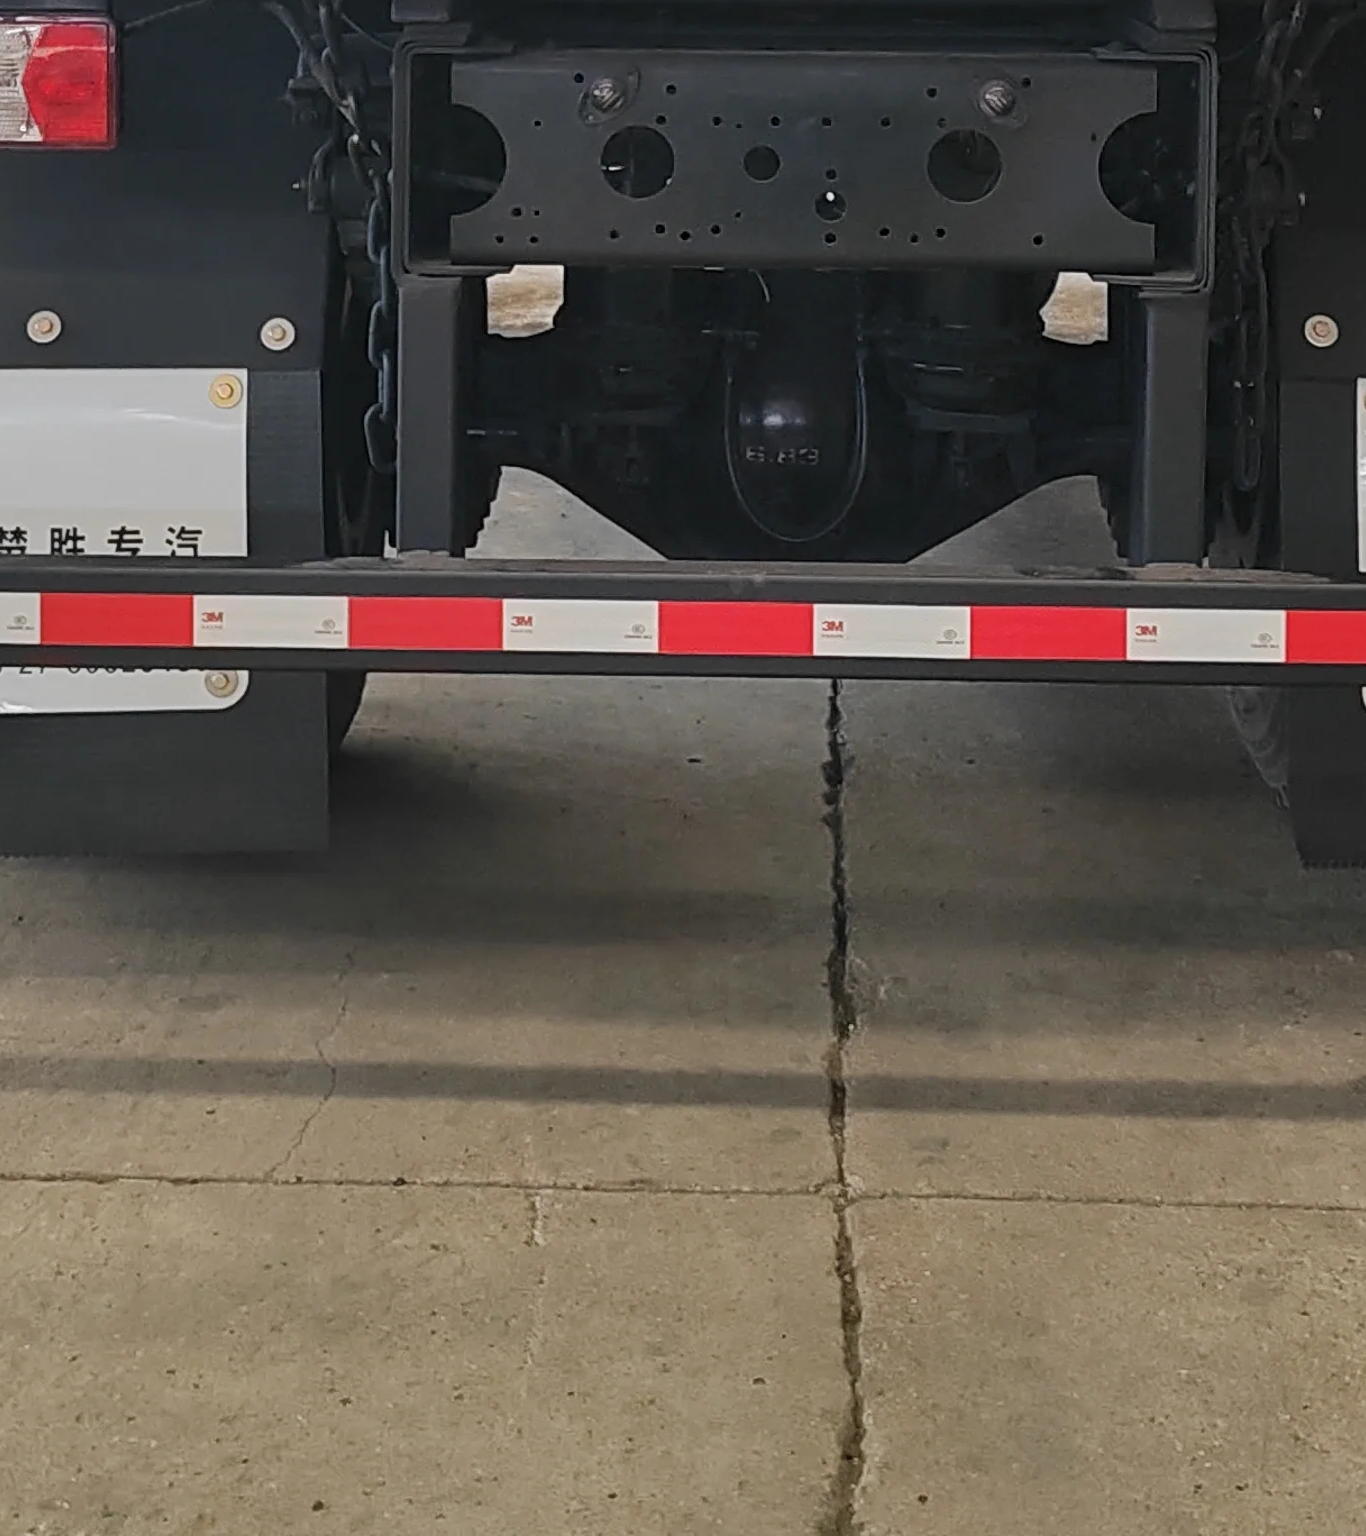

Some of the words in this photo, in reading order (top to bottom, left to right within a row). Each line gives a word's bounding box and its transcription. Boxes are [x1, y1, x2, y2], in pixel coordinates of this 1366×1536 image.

[201, 611, 224, 623] 3M
[510, 615, 533, 627] 3M
[821, 621, 844, 632] 3M
[1135, 625, 1158, 637] 3M
